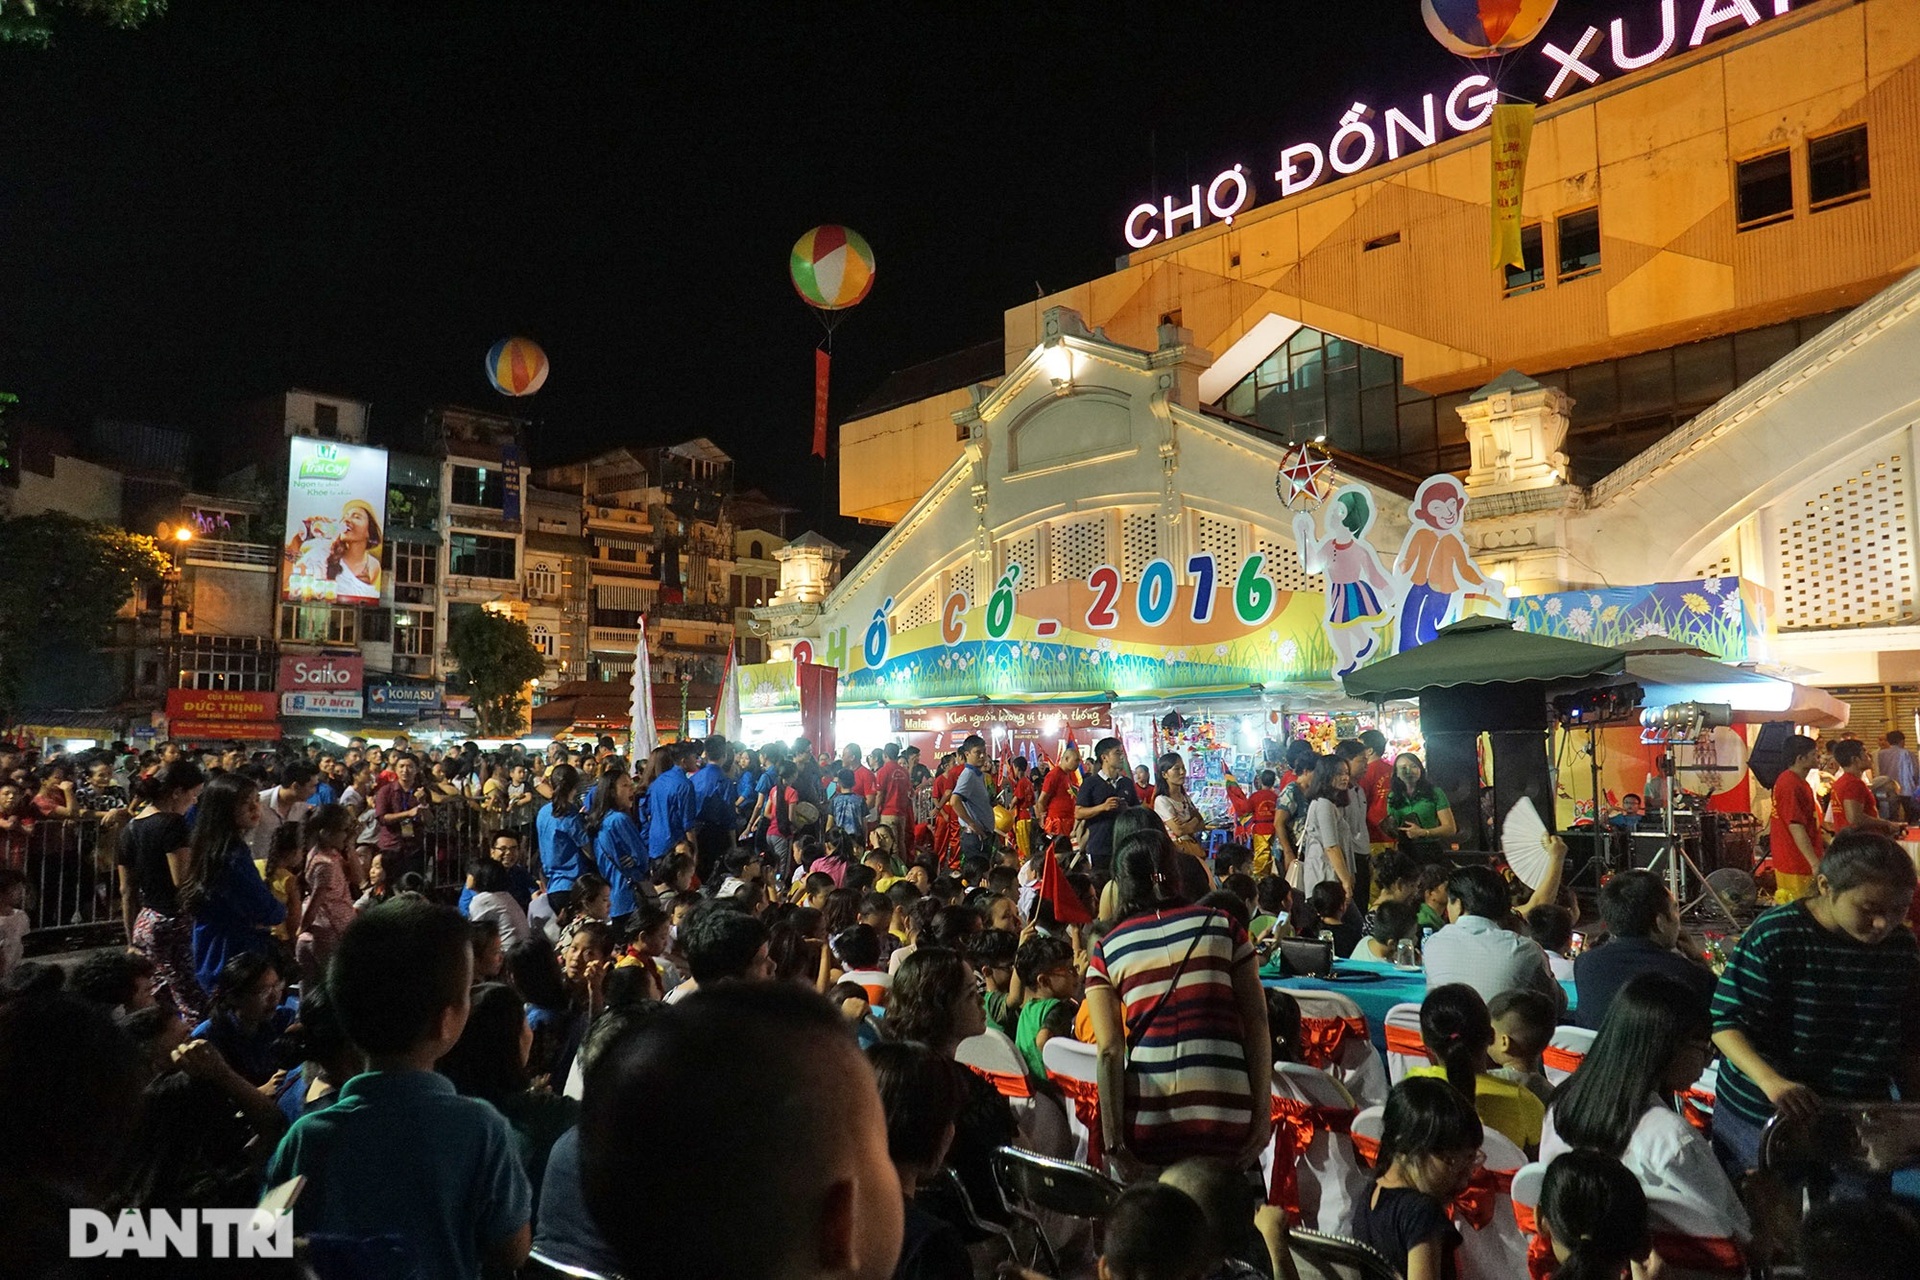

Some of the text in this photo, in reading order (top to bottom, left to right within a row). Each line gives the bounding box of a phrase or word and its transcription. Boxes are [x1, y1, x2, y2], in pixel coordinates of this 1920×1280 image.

[1125, 164, 1247, 249] CHỢ
[1275, 75, 1498, 197] ĐỒNG
[942, 563, 1020, 646] CỔ
[1087, 553, 1276, 628] 2016
[294, 662, 351, 684] Saiko
[184, 699, 264, 713] ĐỨC THỊNH
[388, 689, 435, 701] KOMASU
